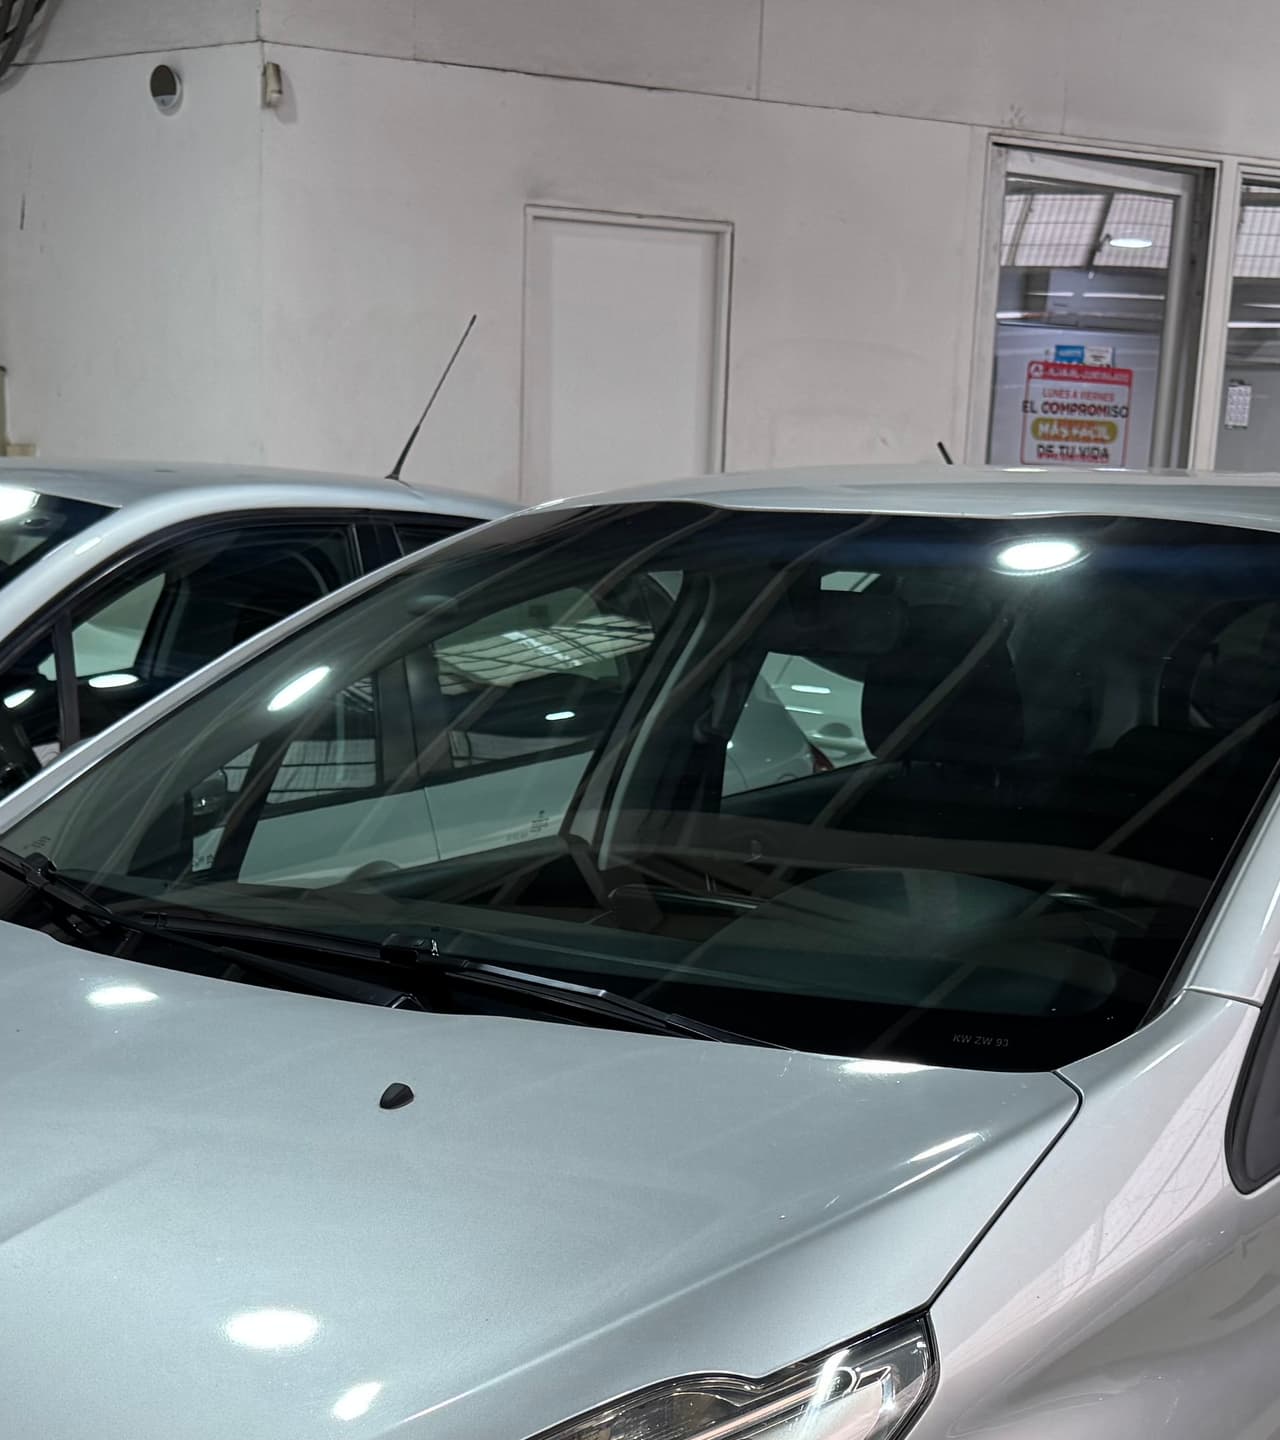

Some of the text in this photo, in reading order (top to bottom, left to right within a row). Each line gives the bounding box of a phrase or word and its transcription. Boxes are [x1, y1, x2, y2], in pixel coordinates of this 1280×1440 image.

[1022, 400, 1130, 418] EL COMPROMISO
[1036, 444, 1056, 459] DE
[1078, 447, 1110, 462] VIDA
